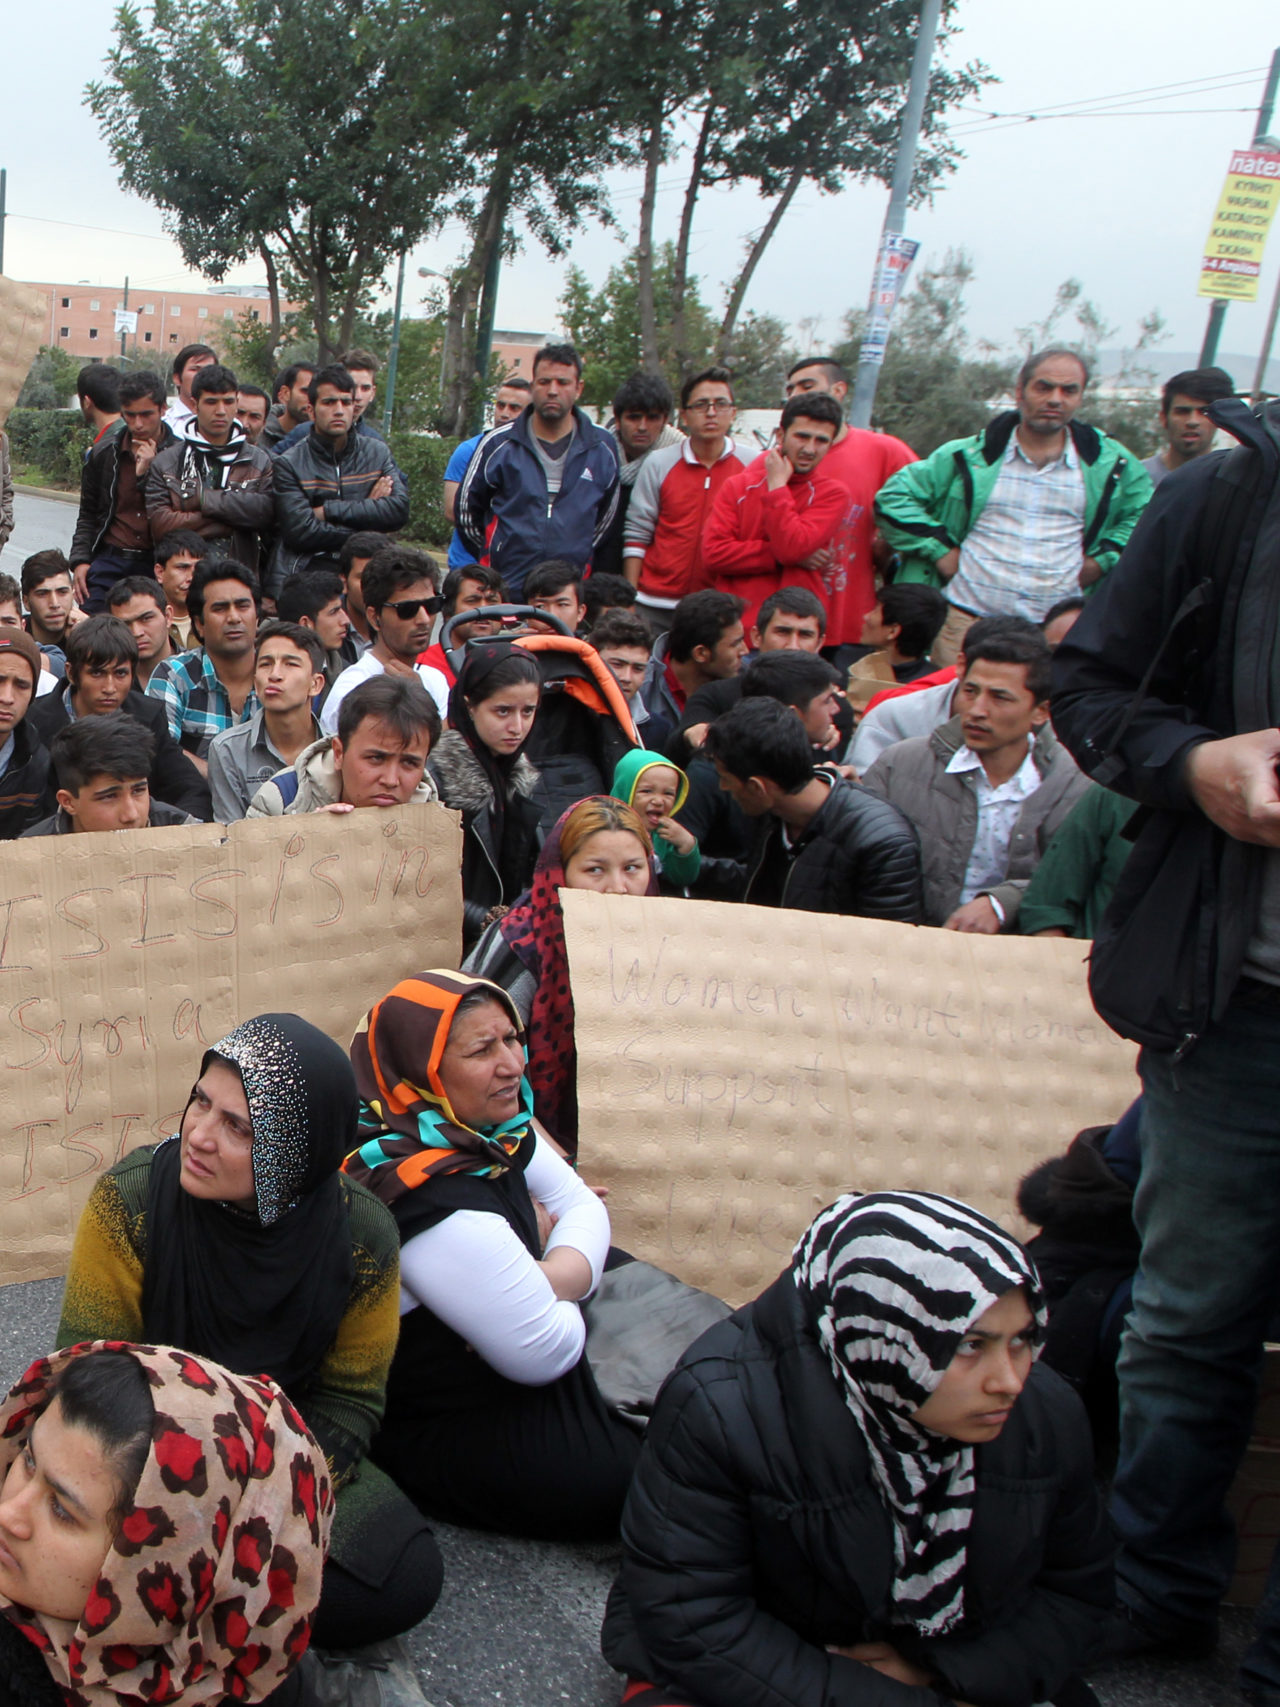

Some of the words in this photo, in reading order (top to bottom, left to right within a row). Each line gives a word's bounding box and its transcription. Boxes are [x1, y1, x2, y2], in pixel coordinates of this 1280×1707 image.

[607, 936, 805, 1020] Women
[5, 996, 210, 1115] Syria
[613, 1029, 848, 1145] Support
